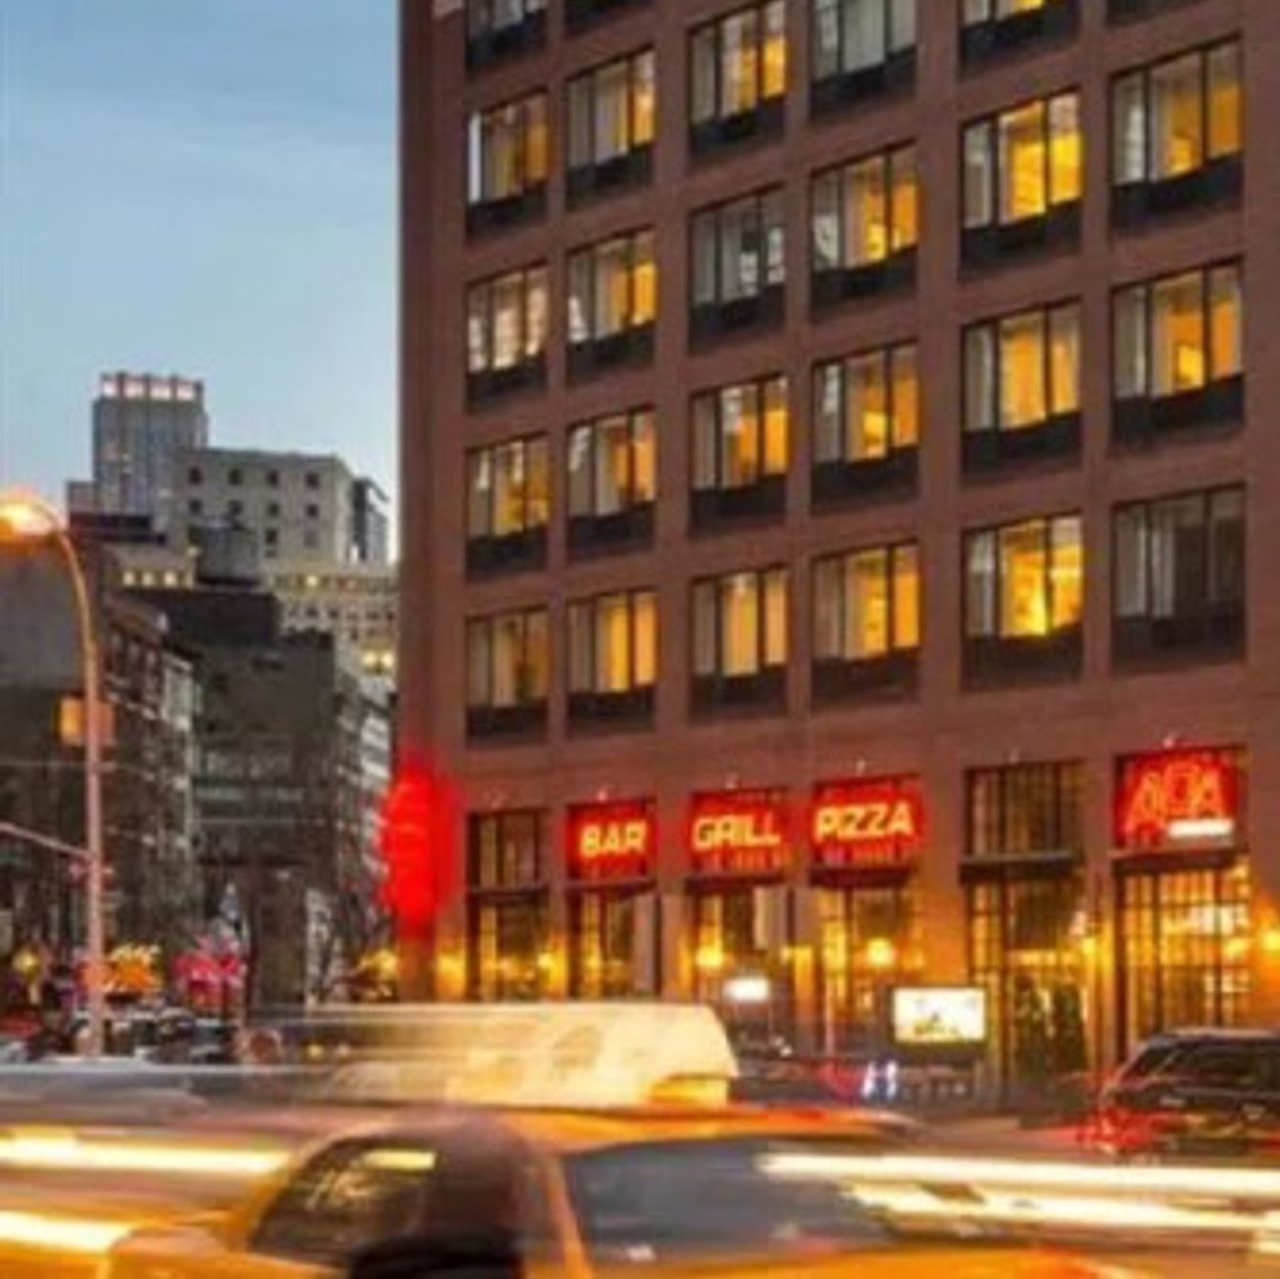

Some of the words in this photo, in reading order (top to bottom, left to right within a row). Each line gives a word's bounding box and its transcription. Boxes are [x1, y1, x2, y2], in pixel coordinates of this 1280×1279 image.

[578, 820, 647, 858] BAR
[691, 813, 781, 852] GRILL
[813, 801, 914, 843] PIZZA
